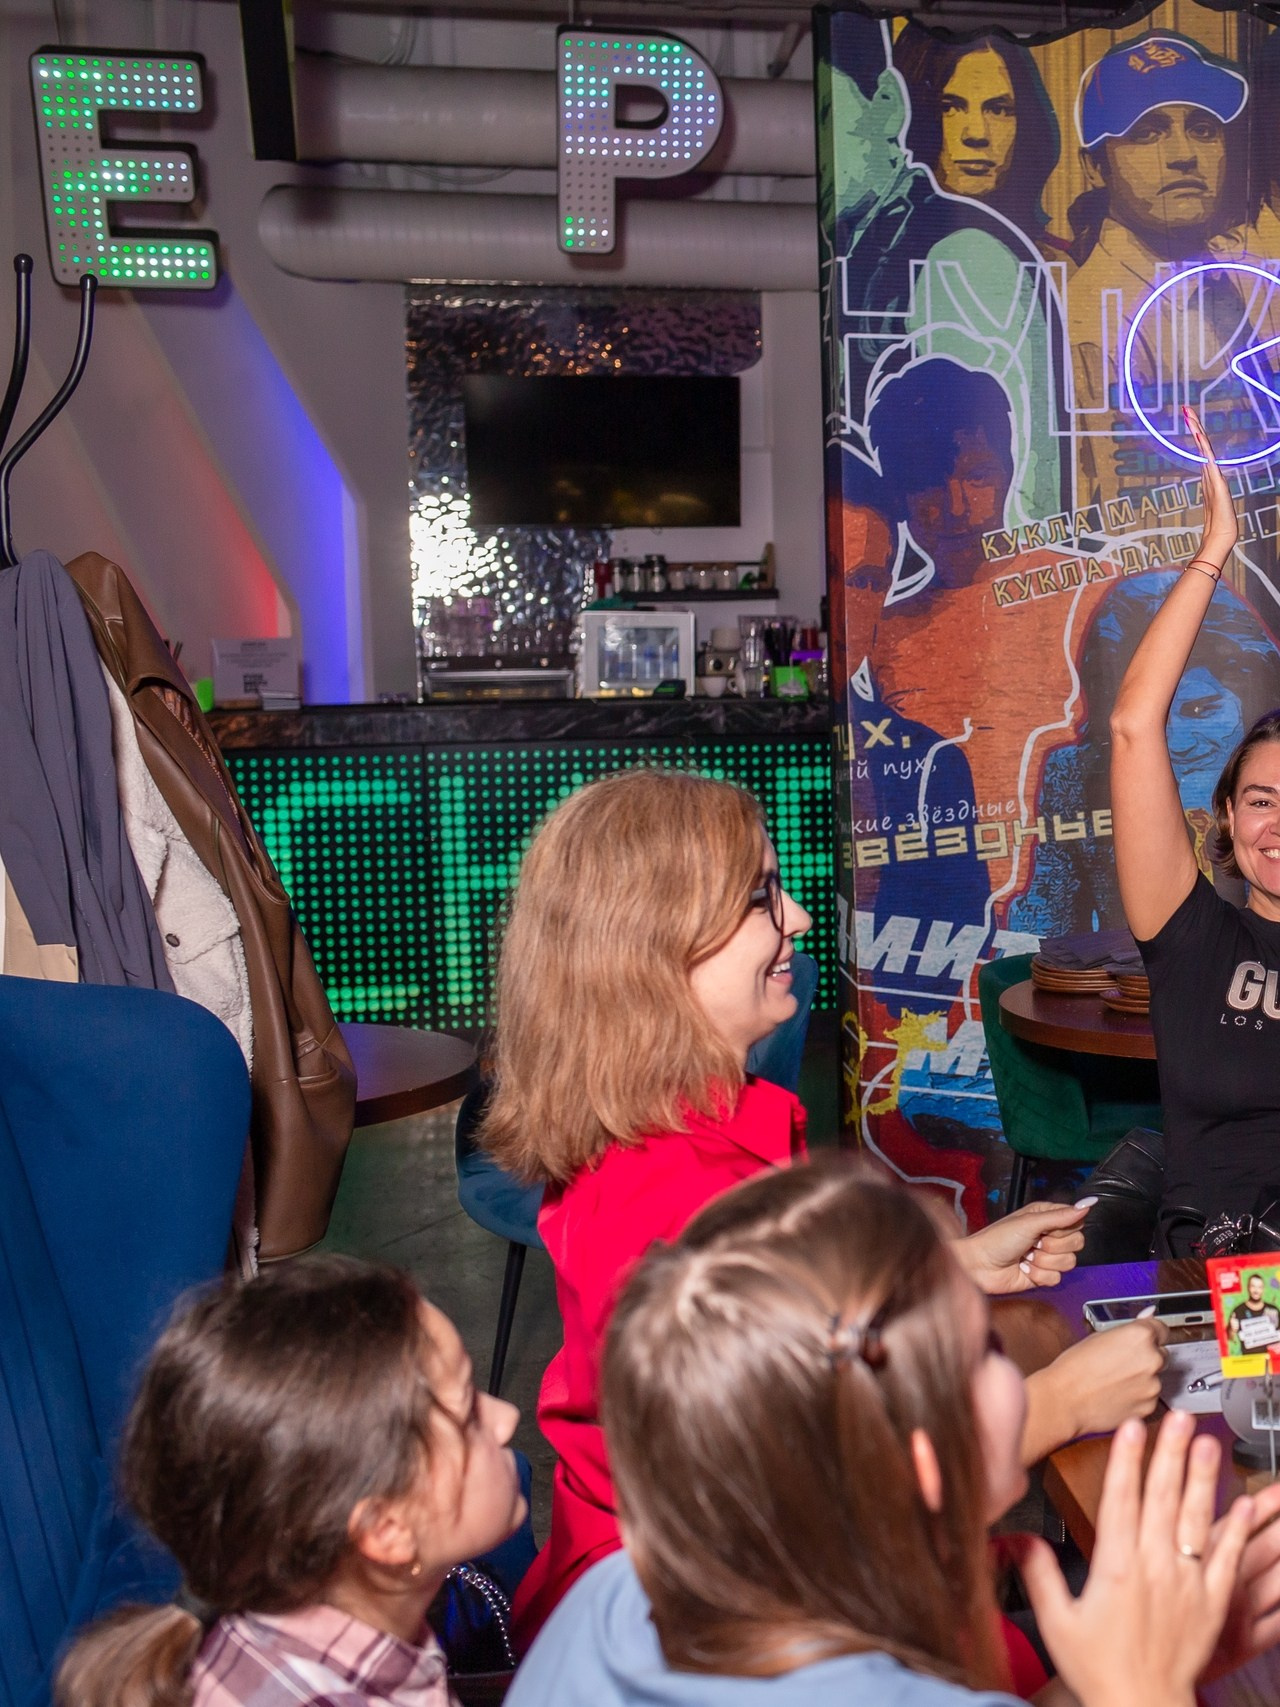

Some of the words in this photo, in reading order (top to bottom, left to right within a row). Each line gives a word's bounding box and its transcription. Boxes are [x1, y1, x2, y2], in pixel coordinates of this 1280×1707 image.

[981, 514, 1092, 561] КУКЛА
[993, 558, 1106, 606] КУКЛА
[1122, 532, 1198, 576] ДАШ
[1220, 1013, 1263, 1031] LOS
